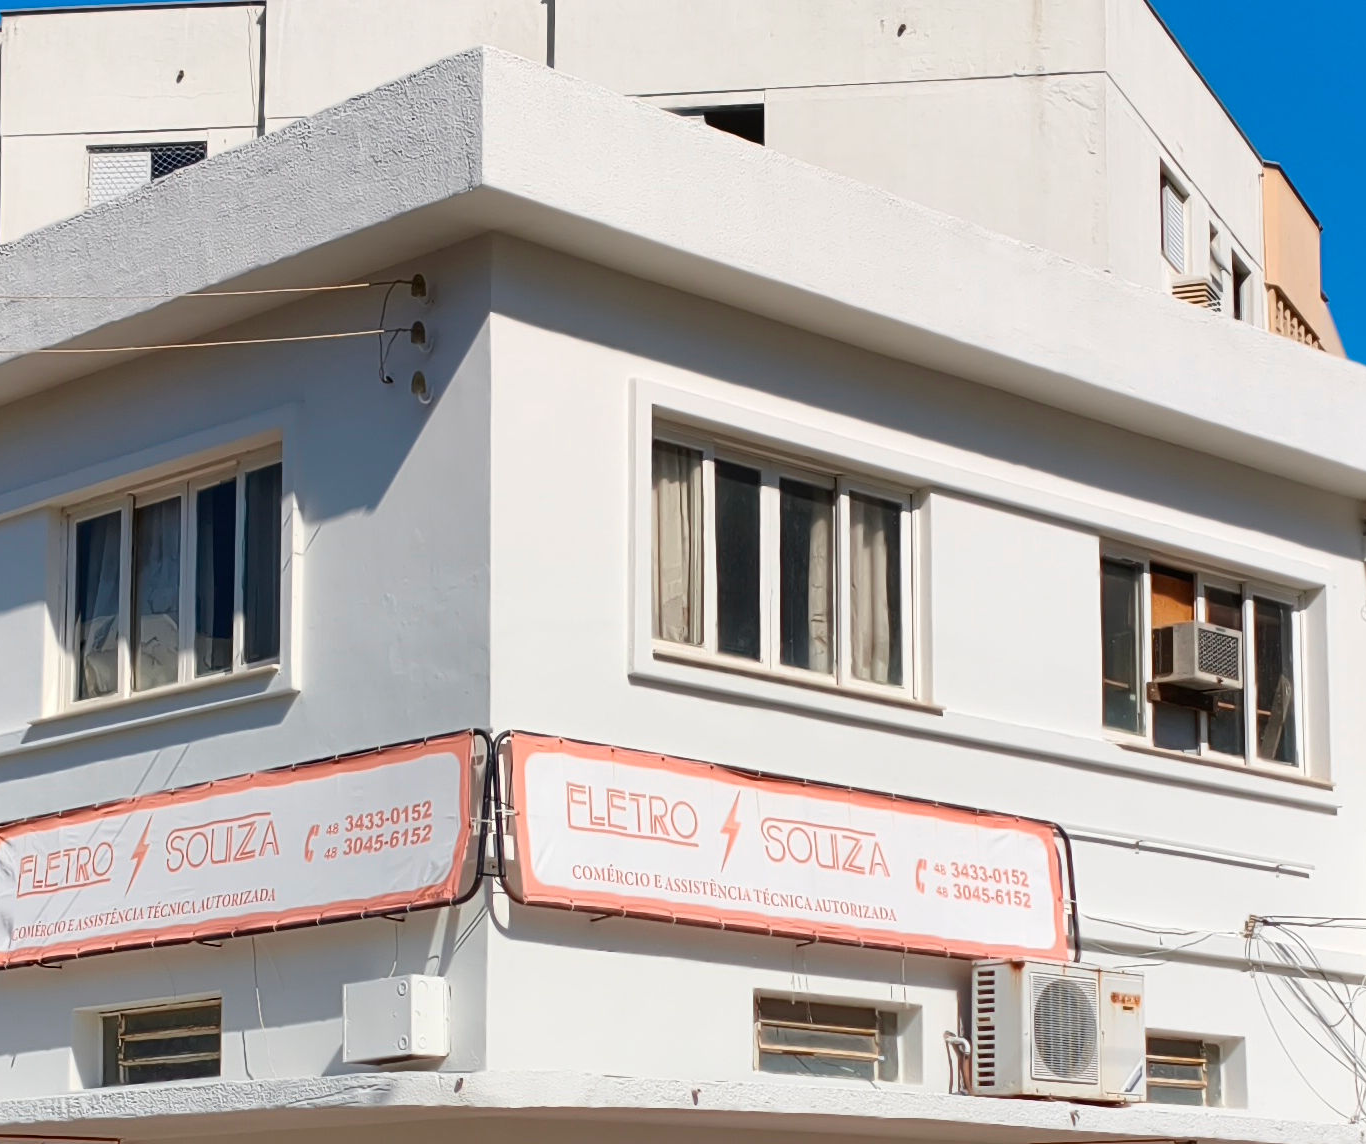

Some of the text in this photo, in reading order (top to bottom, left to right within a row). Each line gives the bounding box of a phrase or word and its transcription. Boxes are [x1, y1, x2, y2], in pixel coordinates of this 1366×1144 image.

[326, 800, 433, 837] 48 3433-0152
[566, 782, 891, 878] ELETRO SOUZA
[17, 812, 280, 898] ELETRO SOUZA
[324, 824, 433, 861] 48 3045-6152
[572, 863, 897, 923] COMÉRCIO E ASSISTÊNCIA TÉCNICA AUTORIZADA
[934, 862, 1030, 888] 48 3433-0152
[936, 883, 1032, 909] 48 3045-6152
[11, 887, 277, 941] COMÉRCIO E ASSISTÊNCIA TÉCNICA AUTORIZADA
